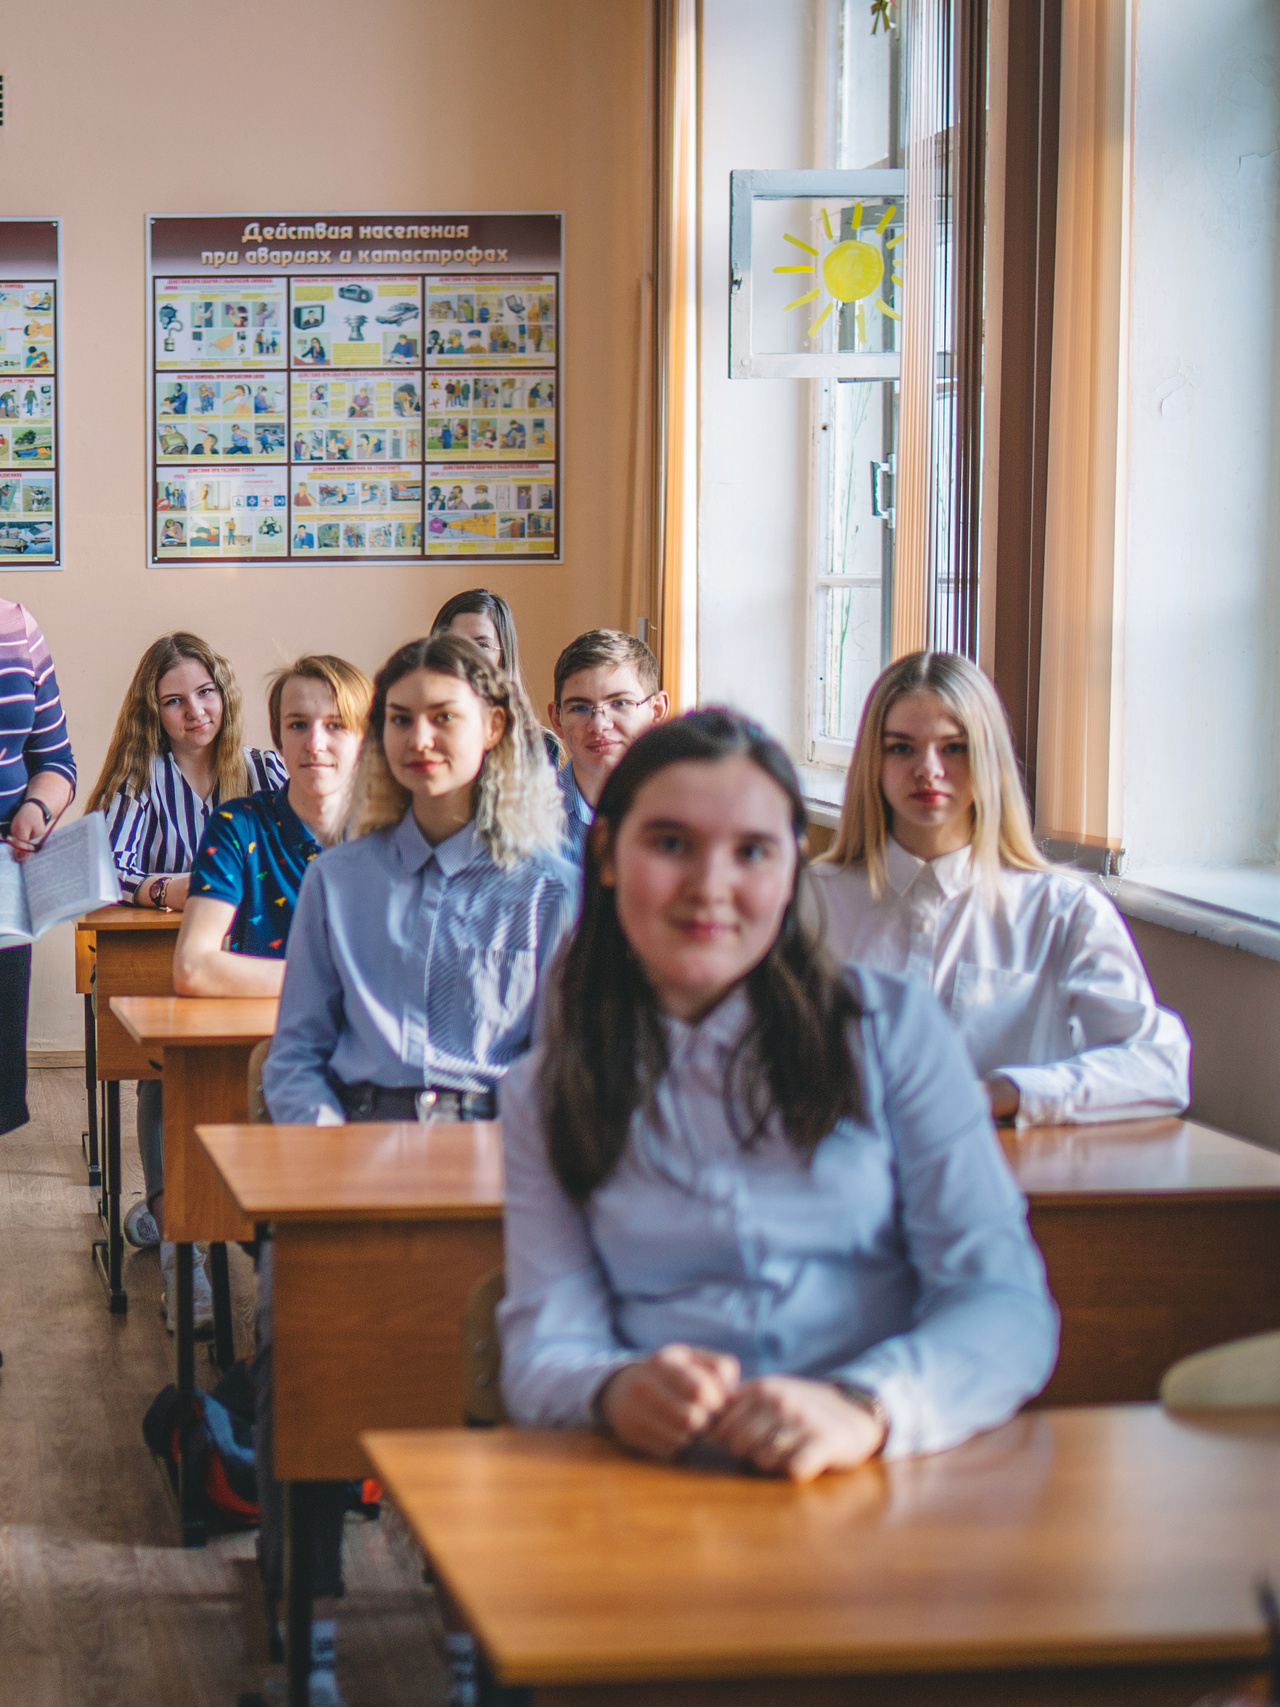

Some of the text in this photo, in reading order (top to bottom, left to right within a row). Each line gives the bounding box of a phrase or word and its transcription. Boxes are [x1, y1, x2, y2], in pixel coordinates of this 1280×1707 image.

[242, 222, 470, 244] Действия населения
[201, 245, 509, 268] при авариях и катастрофах
